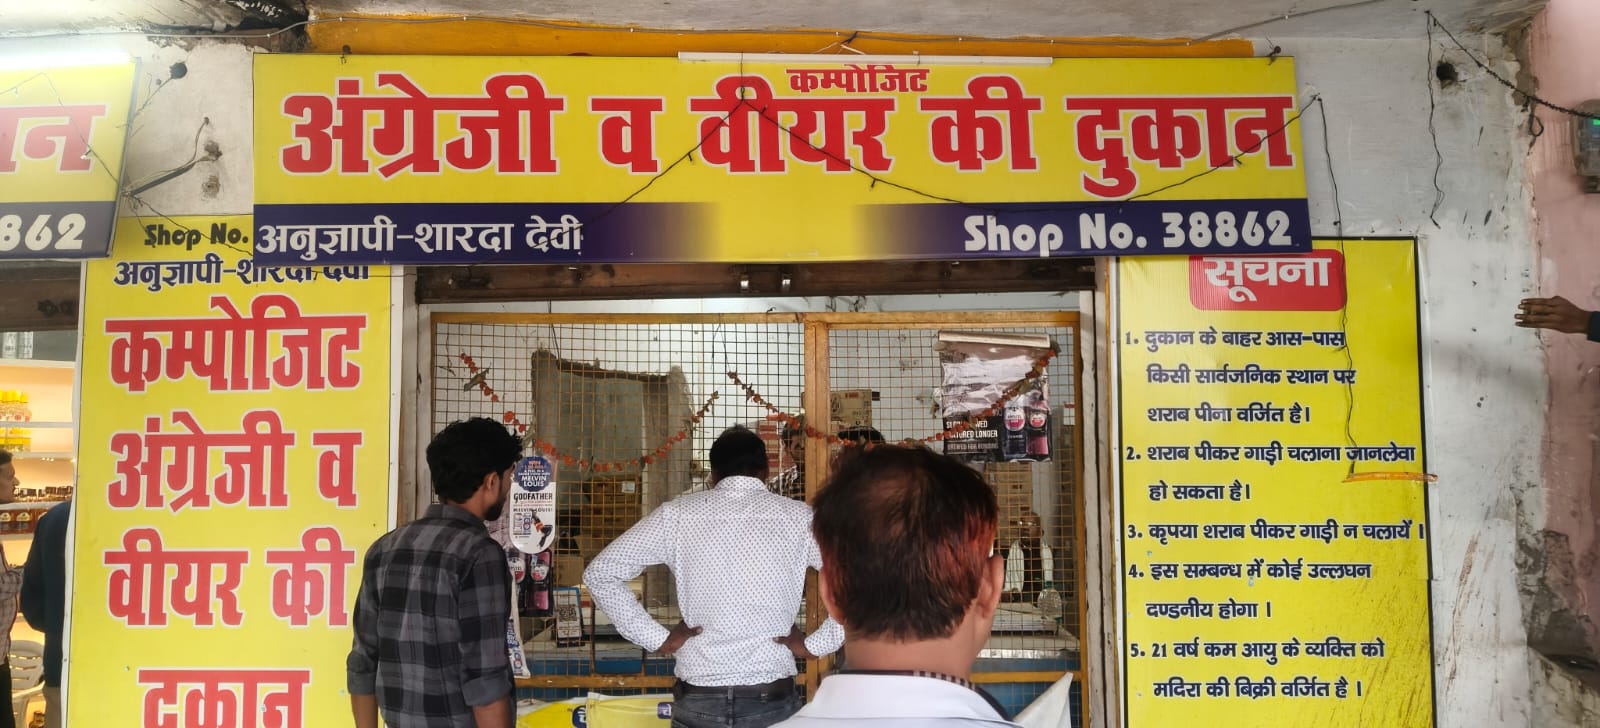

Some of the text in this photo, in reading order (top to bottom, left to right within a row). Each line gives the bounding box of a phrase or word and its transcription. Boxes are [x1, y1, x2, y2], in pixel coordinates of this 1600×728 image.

[786, 65, 930, 93] कम्पोजिट
[282, 73, 565, 179] अंग्रेजी
[590, 98, 663, 174] व
[920, 75, 1042, 171] की
[1066, 96, 1293, 197] दुकान
[144, 223, 248, 250] Shop No.
[526, 215, 582, 251] देवी
[964, 210, 1293, 257] Shop No. 38862
[1203, 257, 1332, 302] सूचना
[105, 295, 366, 392] कम्पोजिट
[1125, 326, 1345, 352] 1. दुकान के बाहर आस-पास
[1146, 364, 1356, 384] किसी सार्वजनिक स्थान पर
[1148, 407, 1189, 422] शराब
[1195, 402, 1232, 422] पीना
[1236, 402, 1284, 423] वर्जित
[107, 411, 362, 513] अंग्रेजी व
[1126, 440, 1416, 466] 2. शराब पीकर गाड़ी चलाना जानलेवा
[513, 492, 553, 503] GODFATHER
[1148, 480, 1168, 500] हो
[1172, 485, 1224, 500] सकता
[1127, 525, 1143, 539] 3.
[1148, 524, 1199, 545] कृपया
[1203, 524, 1245, 539] शराब
[1250, 518, 1296, 539] पीकर
[1300, 518, 1339, 545] गाड़ी
[1343, 524, 1358, 539] न
[1363, 520, 1412, 540] चलायें
[266, 527, 355, 626] की
[1128, 564, 1144, 578] 4.
[1151, 563, 1178, 579] इस
[1184, 563, 1242, 578] सम्बन्ध
[1247, 558, 1265, 579] में
[1267, 558, 1303, 579] कोई
[1146, 597, 1213, 618] दण्डनीय
[1218, 597, 1258, 618] होगा
[1130, 643, 1146, 657] 5.
[1152, 643, 1167, 657] 21
[1173, 637, 1200, 657] वर्ष
[1204, 642, 1236, 657] कम
[1242, 642, 1278, 665] आयु
[1282, 638, 1300, 657] के
[1361, 637, 1385, 657] को
[1153, 676, 1201, 697] मदिरा
[1206, 676, 1230, 697] की
[1235, 676, 1275, 699] बिक्री
[1281, 676, 1330, 697] वर्जित
[1335, 676, 1347, 698] है
